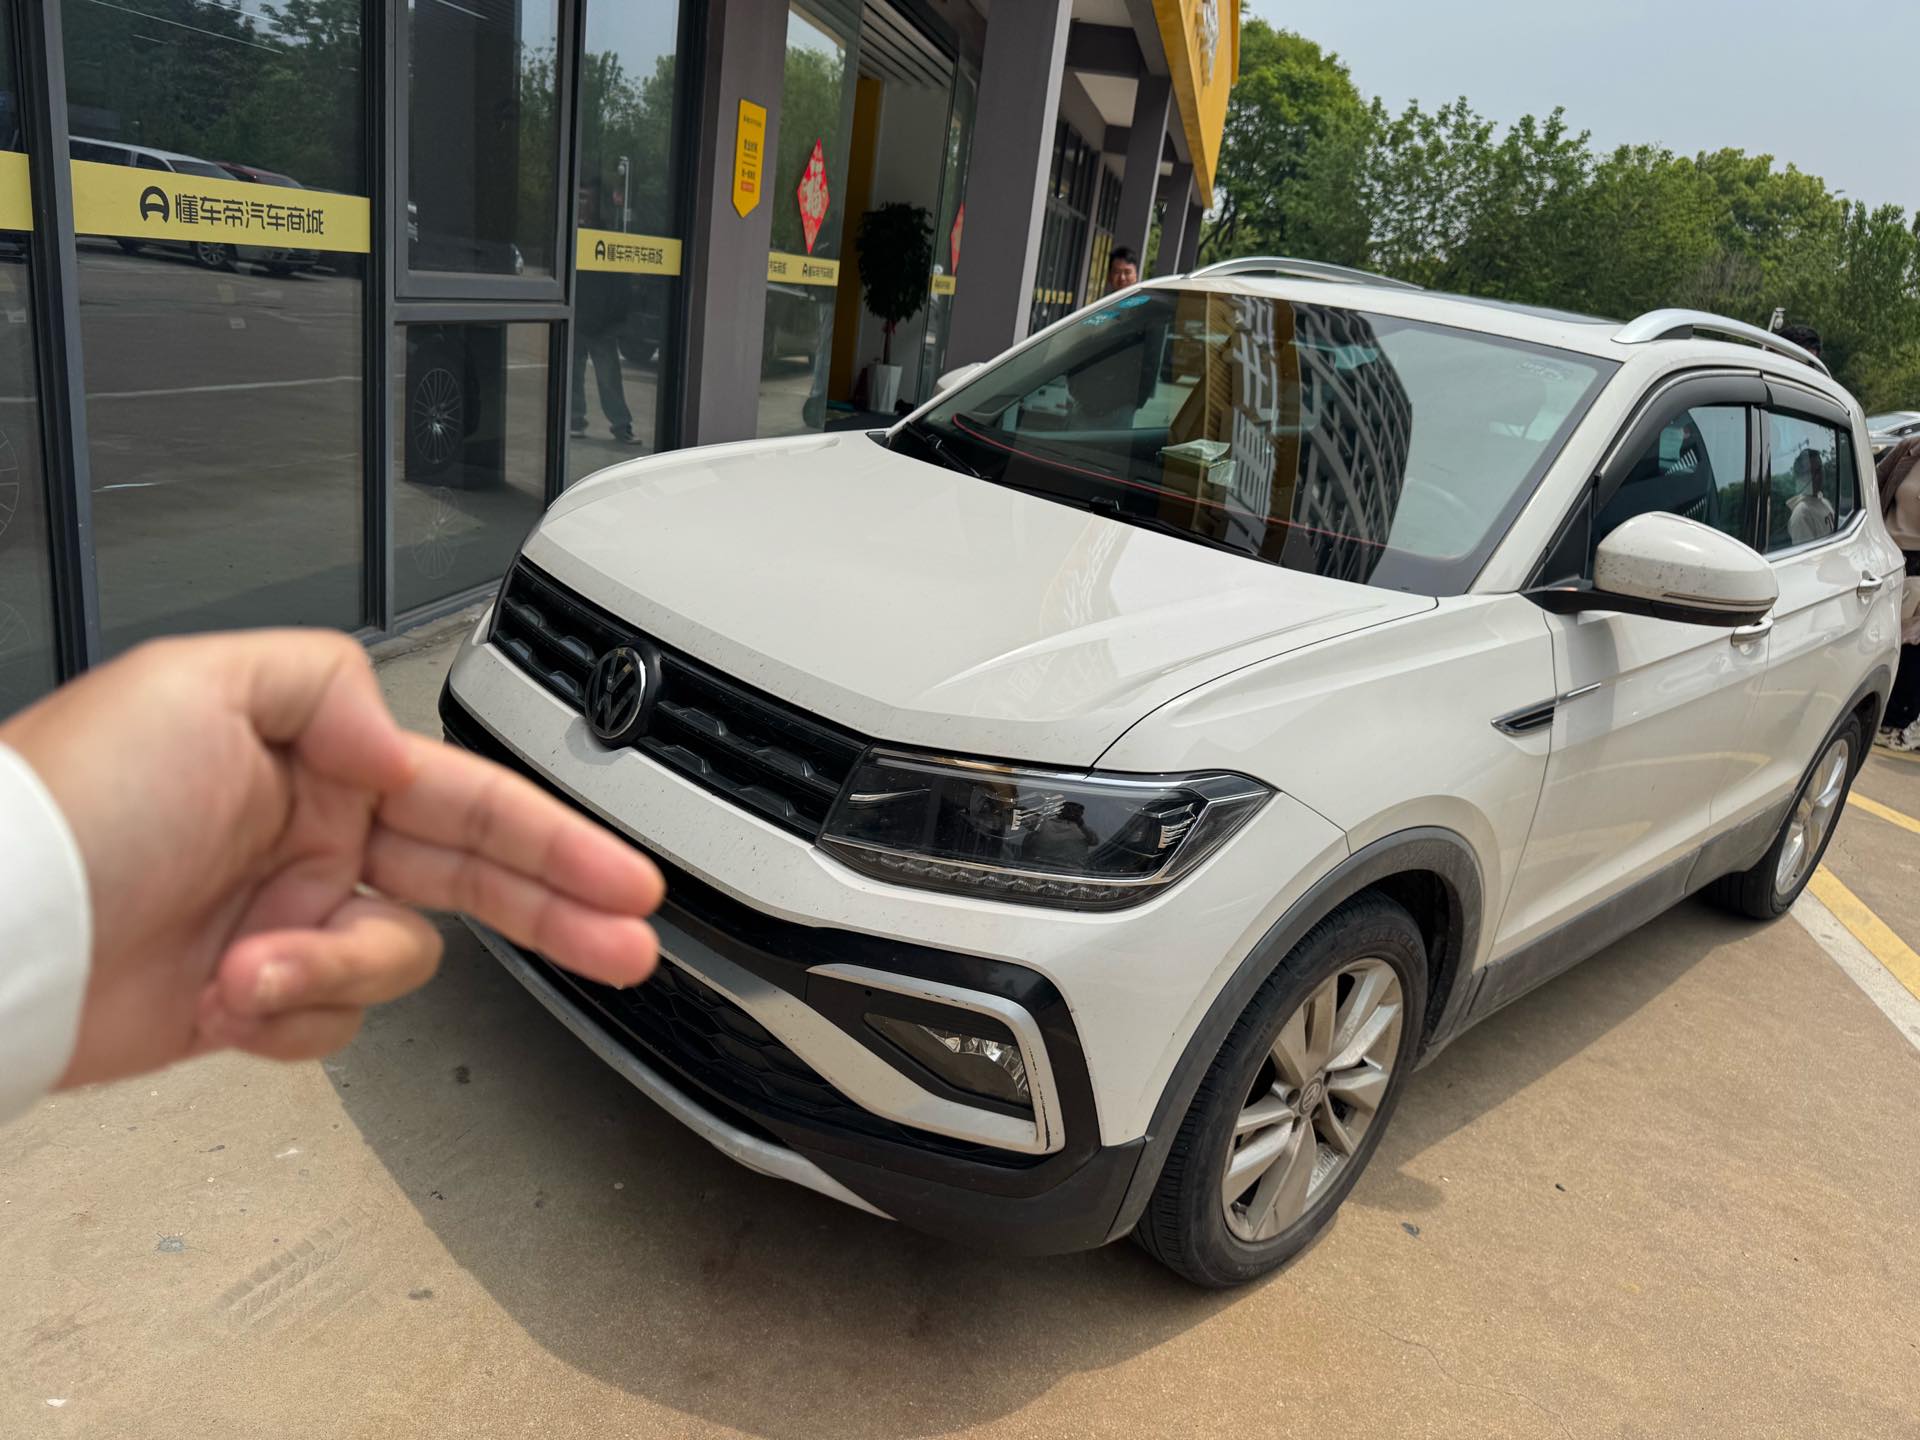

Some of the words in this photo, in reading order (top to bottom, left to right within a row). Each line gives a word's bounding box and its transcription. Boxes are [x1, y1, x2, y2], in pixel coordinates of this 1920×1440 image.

[175, 193, 324, 235] 懂车帝汽车商城
